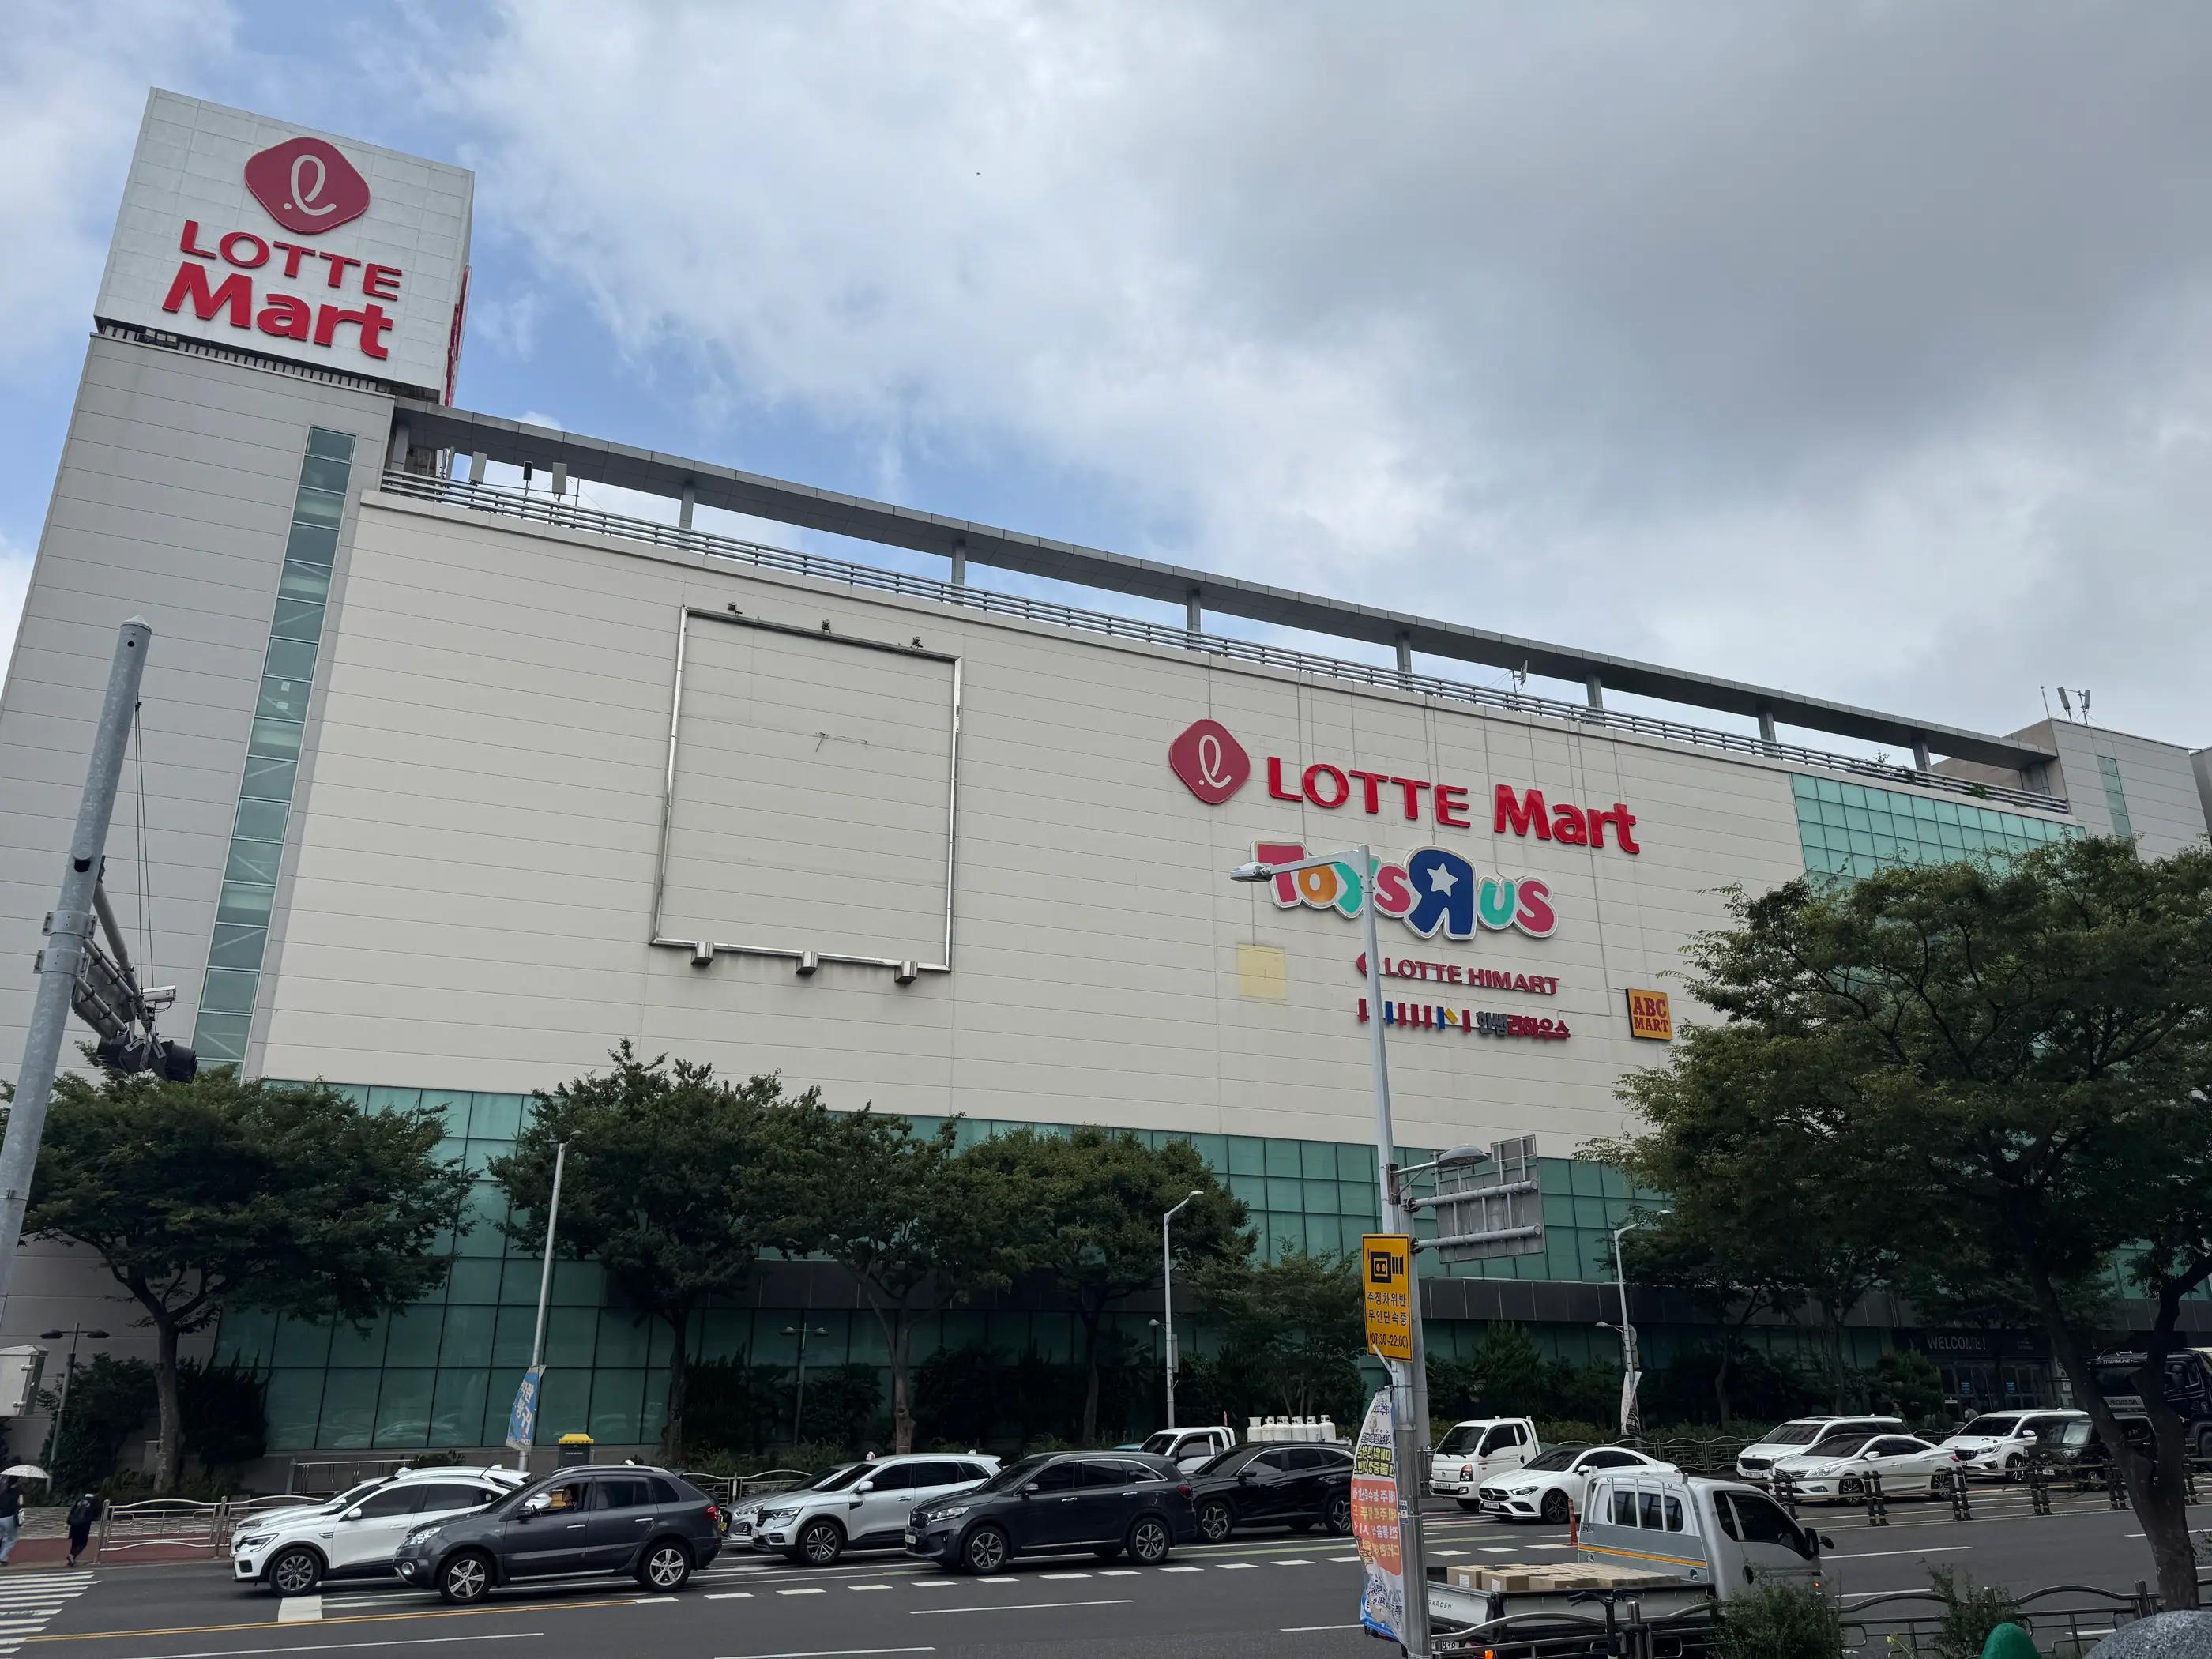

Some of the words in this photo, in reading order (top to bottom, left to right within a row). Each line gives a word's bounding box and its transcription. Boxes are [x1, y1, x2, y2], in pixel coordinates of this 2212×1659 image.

[180, 220, 402, 301] LOTTE
[162, 261, 393, 359] Mart
[1267, 756, 1471, 828] LOTTE
[1494, 783, 1640, 854] Mart
[1385, 957, 1462, 984] LOTTE
[1468, 968, 1560, 995] HIMART
[1633, 995, 1667, 1018] ABC
[1634, 1017, 1668, 1033] MART
[1367, 1291, 1406, 1307] 주정차위반
[1368, 1309, 1407, 1326] 무인단속중
[1928, 1336, 1987, 1350] WELCOE!
